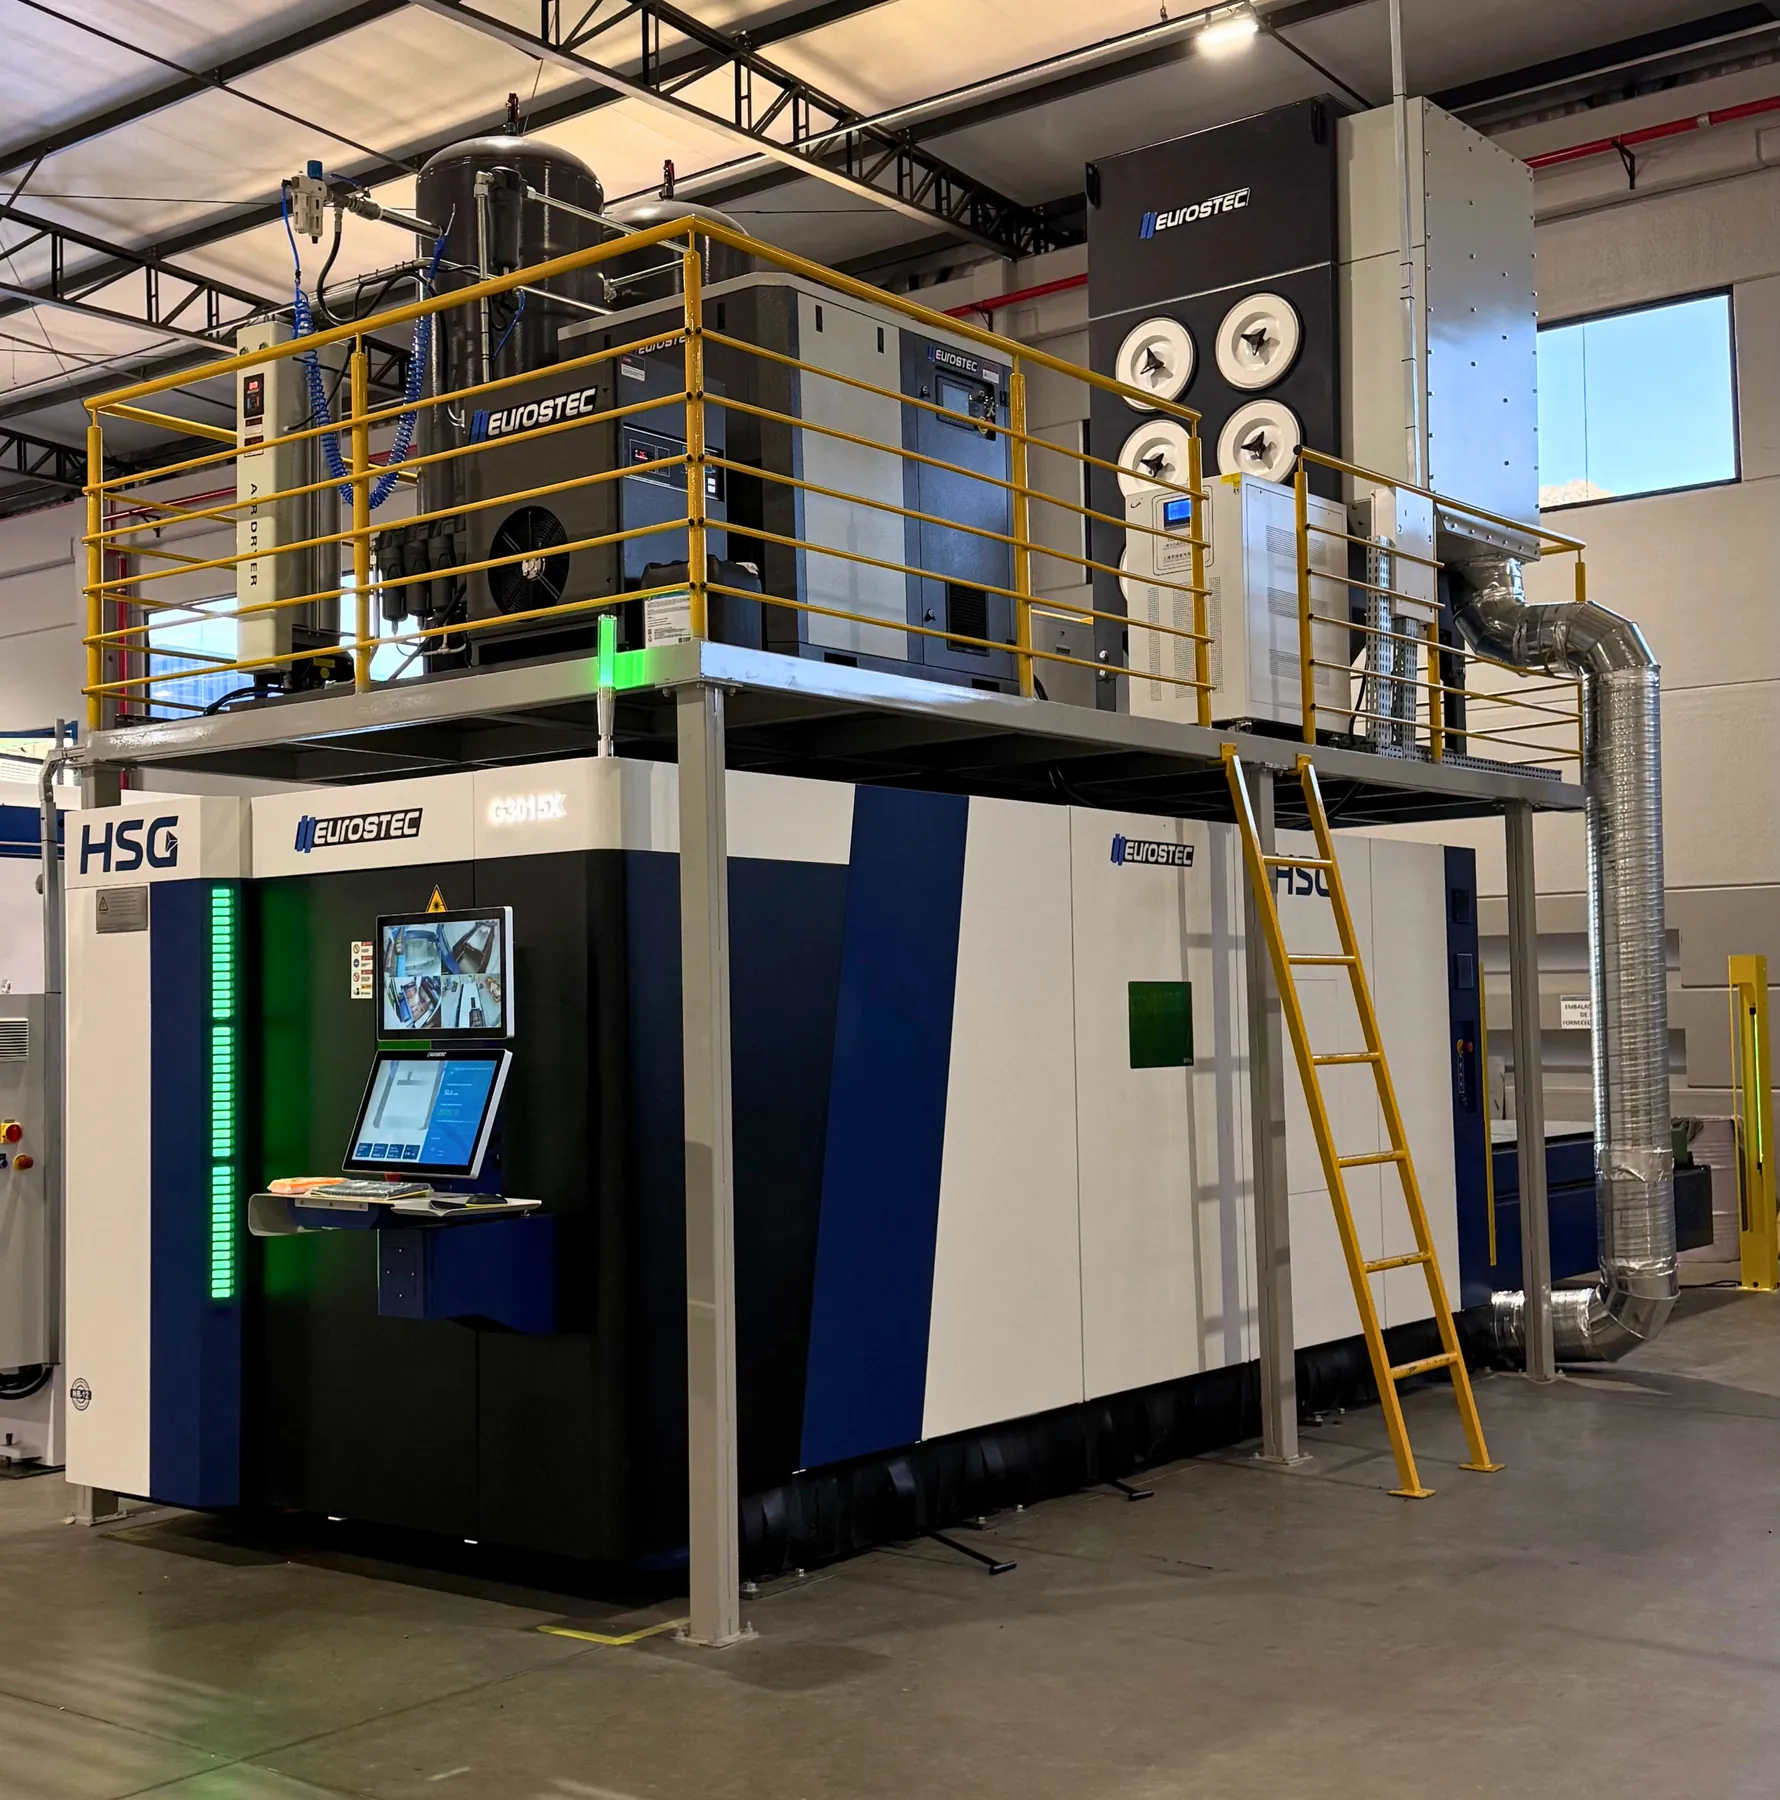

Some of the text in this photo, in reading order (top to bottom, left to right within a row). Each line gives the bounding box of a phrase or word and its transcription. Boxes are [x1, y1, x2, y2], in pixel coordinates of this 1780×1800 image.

[1155, 189, 1248, 231] EUROSTEC
[935, 349, 978, 372] EUROSTEC
[487, 387, 597, 436] EUROSTEC
[80, 815, 179, 874] HSG
[314, 810, 420, 845] EUROSTEC
[1124, 841, 1193, 866] EUROSTEC
